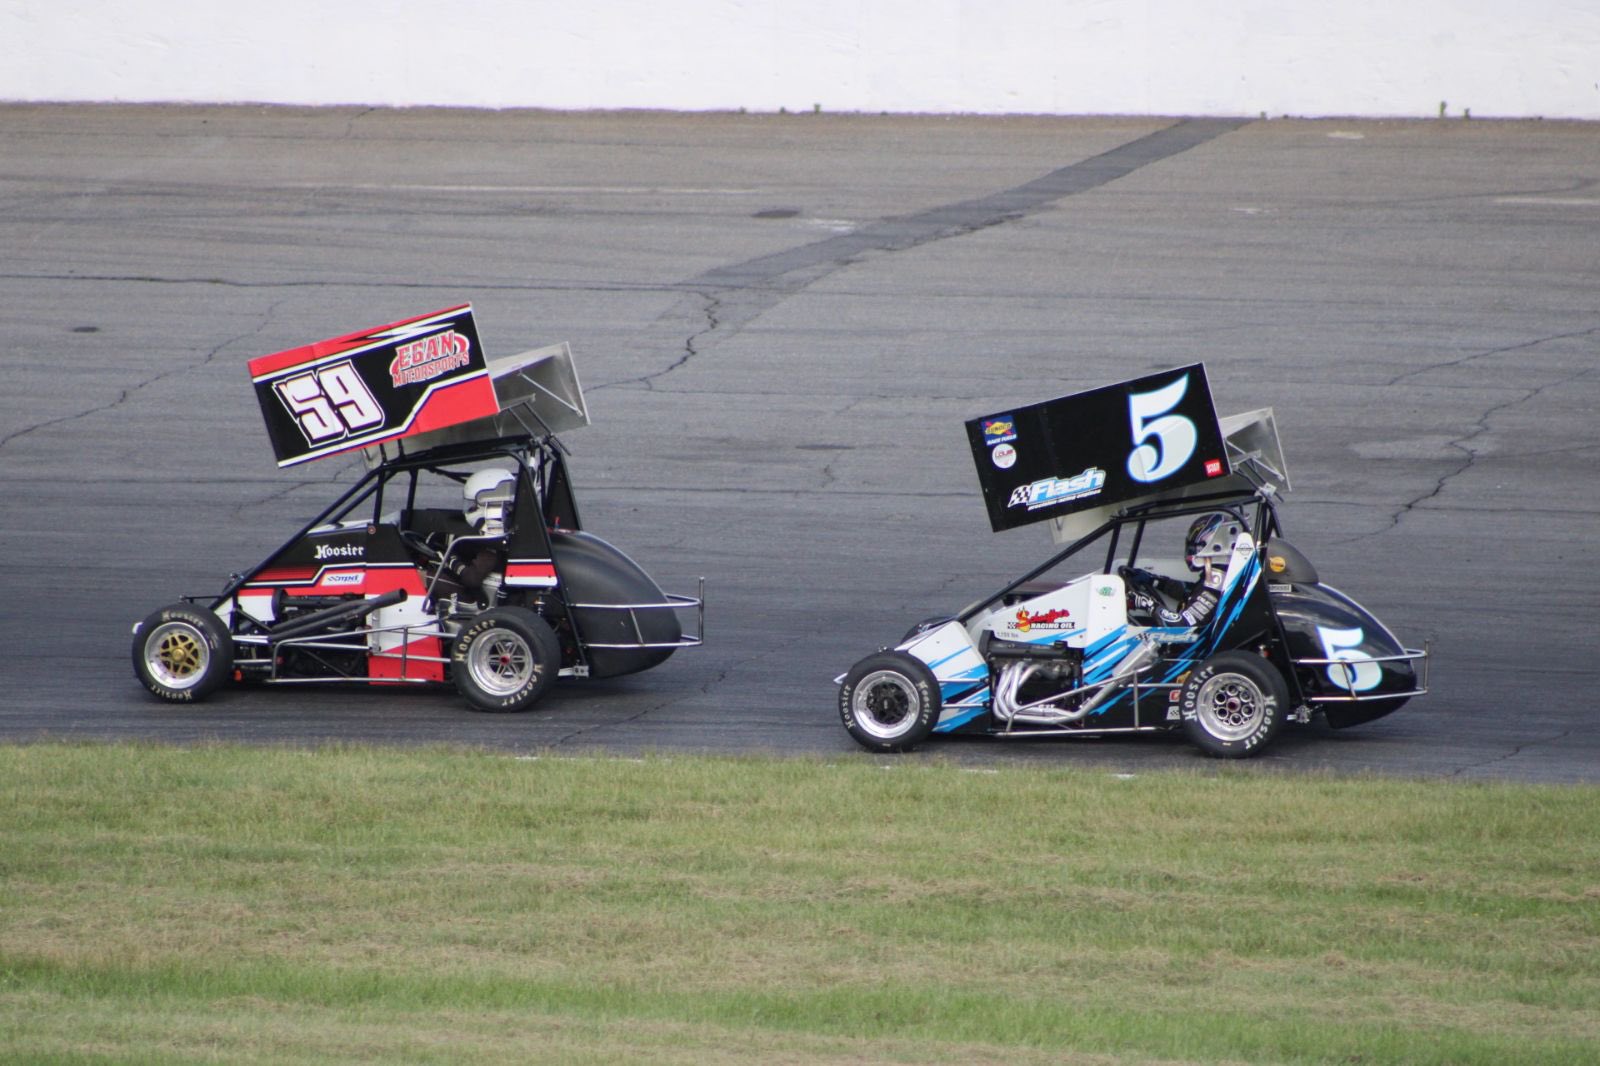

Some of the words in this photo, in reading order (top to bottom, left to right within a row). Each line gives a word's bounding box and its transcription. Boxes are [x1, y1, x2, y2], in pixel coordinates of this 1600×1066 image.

[273, 361, 384, 447] 59
[1127, 373, 1198, 482] 5
[1026, 467, 1106, 506] Flash
[314, 543, 364, 559] Hoosier
[1316, 626, 1383, 692] 5
[1182, 665, 1214, 722] Hoosier
[1243, 694, 1277, 750] Hoosier
